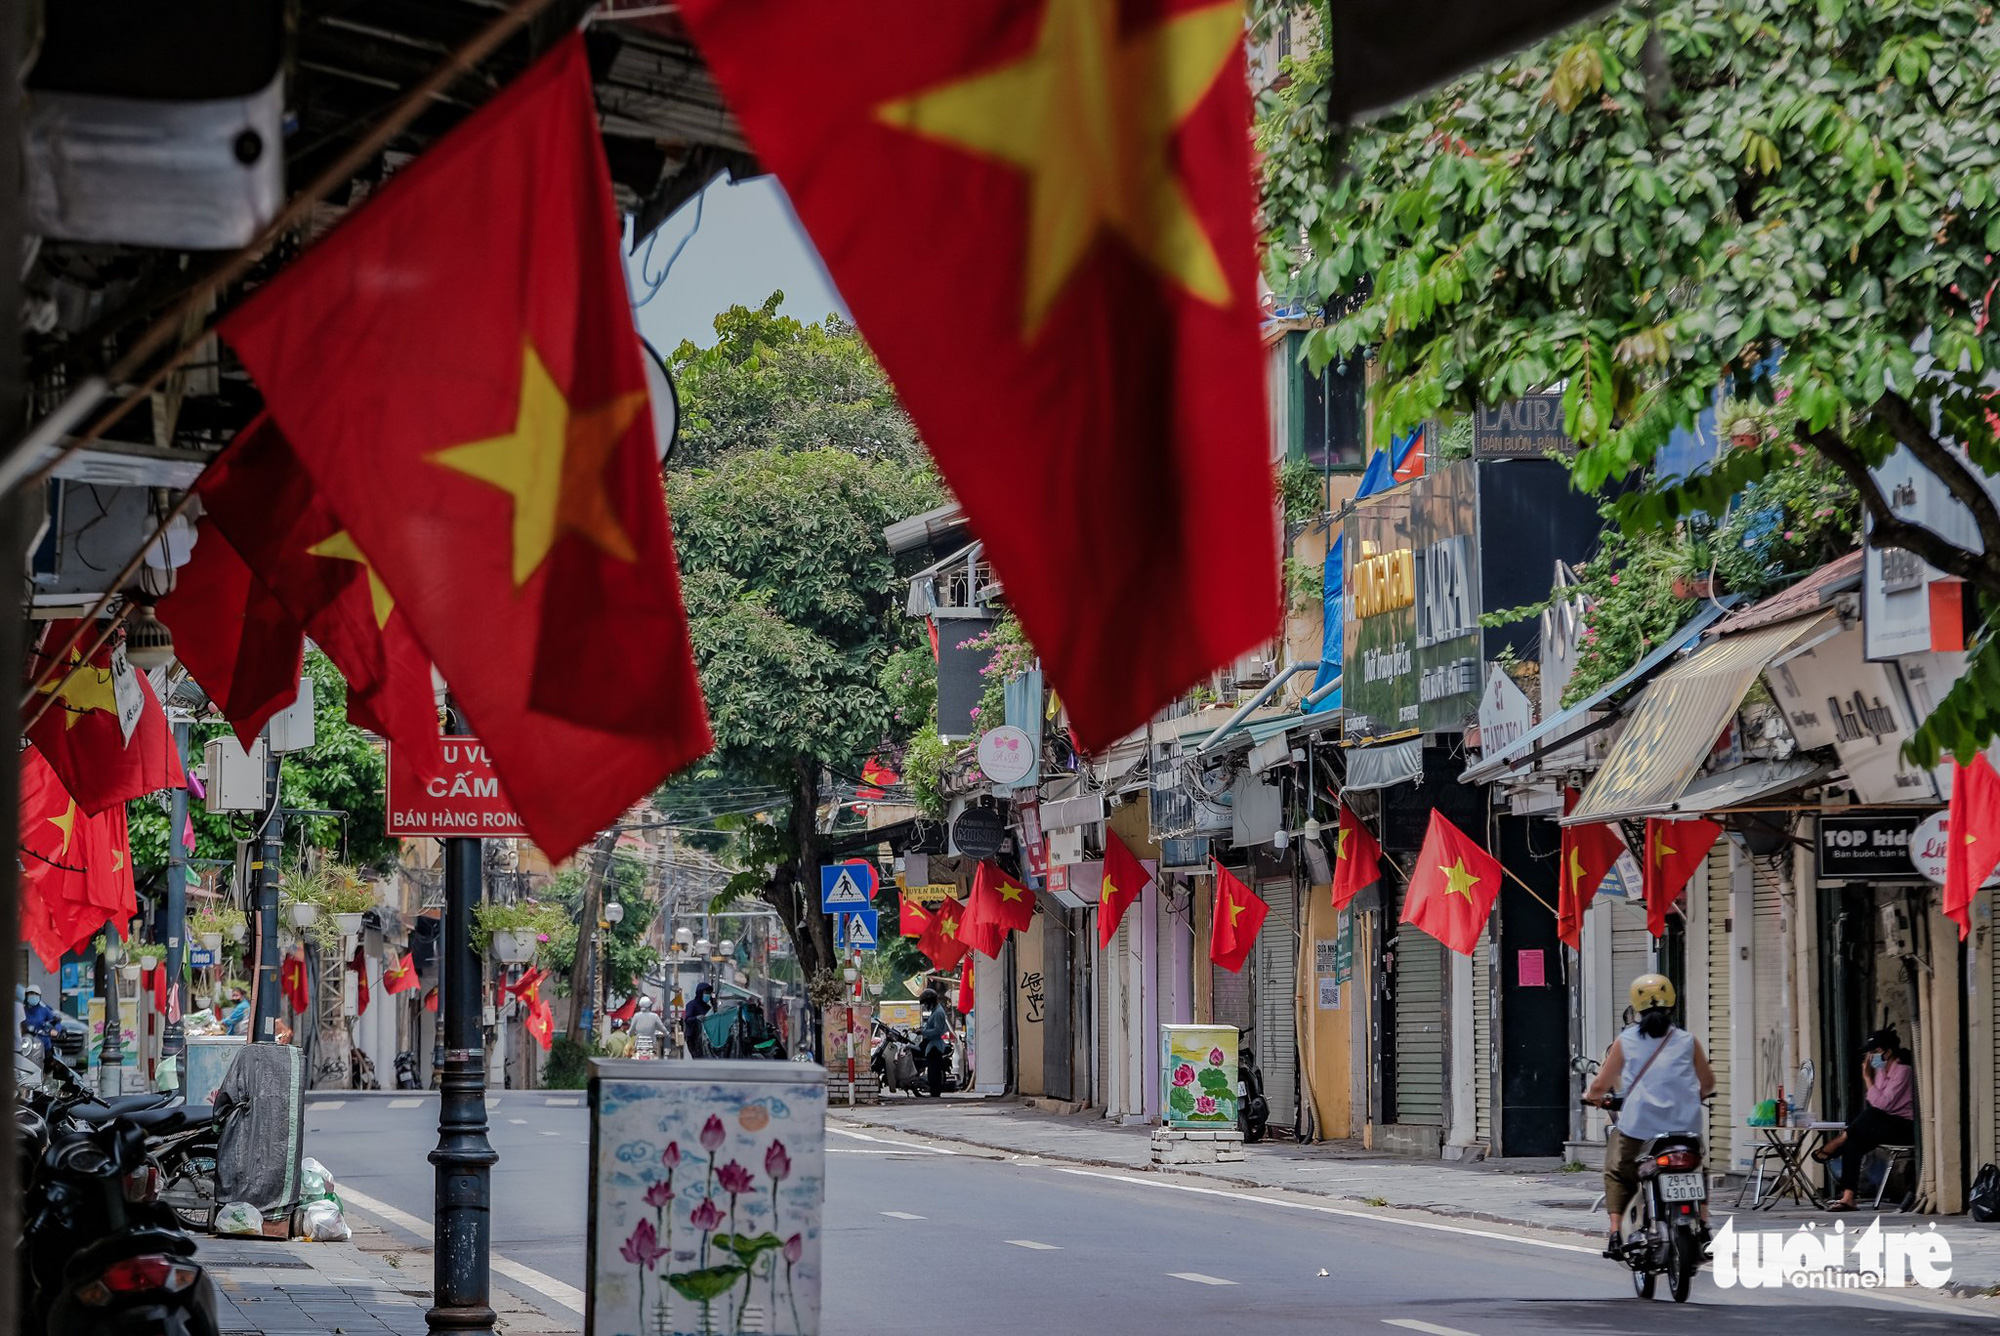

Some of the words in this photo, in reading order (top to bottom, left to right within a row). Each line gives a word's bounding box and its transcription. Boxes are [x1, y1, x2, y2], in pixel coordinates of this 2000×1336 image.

[1413, 534, 1474, 649] LAURA
[426, 770, 498, 797] CẤM
[393, 808, 427, 827] BÁN
[432, 808, 478, 827] HÀNG
[1824, 830, 1867, 847] TOP
[1668, 1174, 1698, 1187] 29-C1
